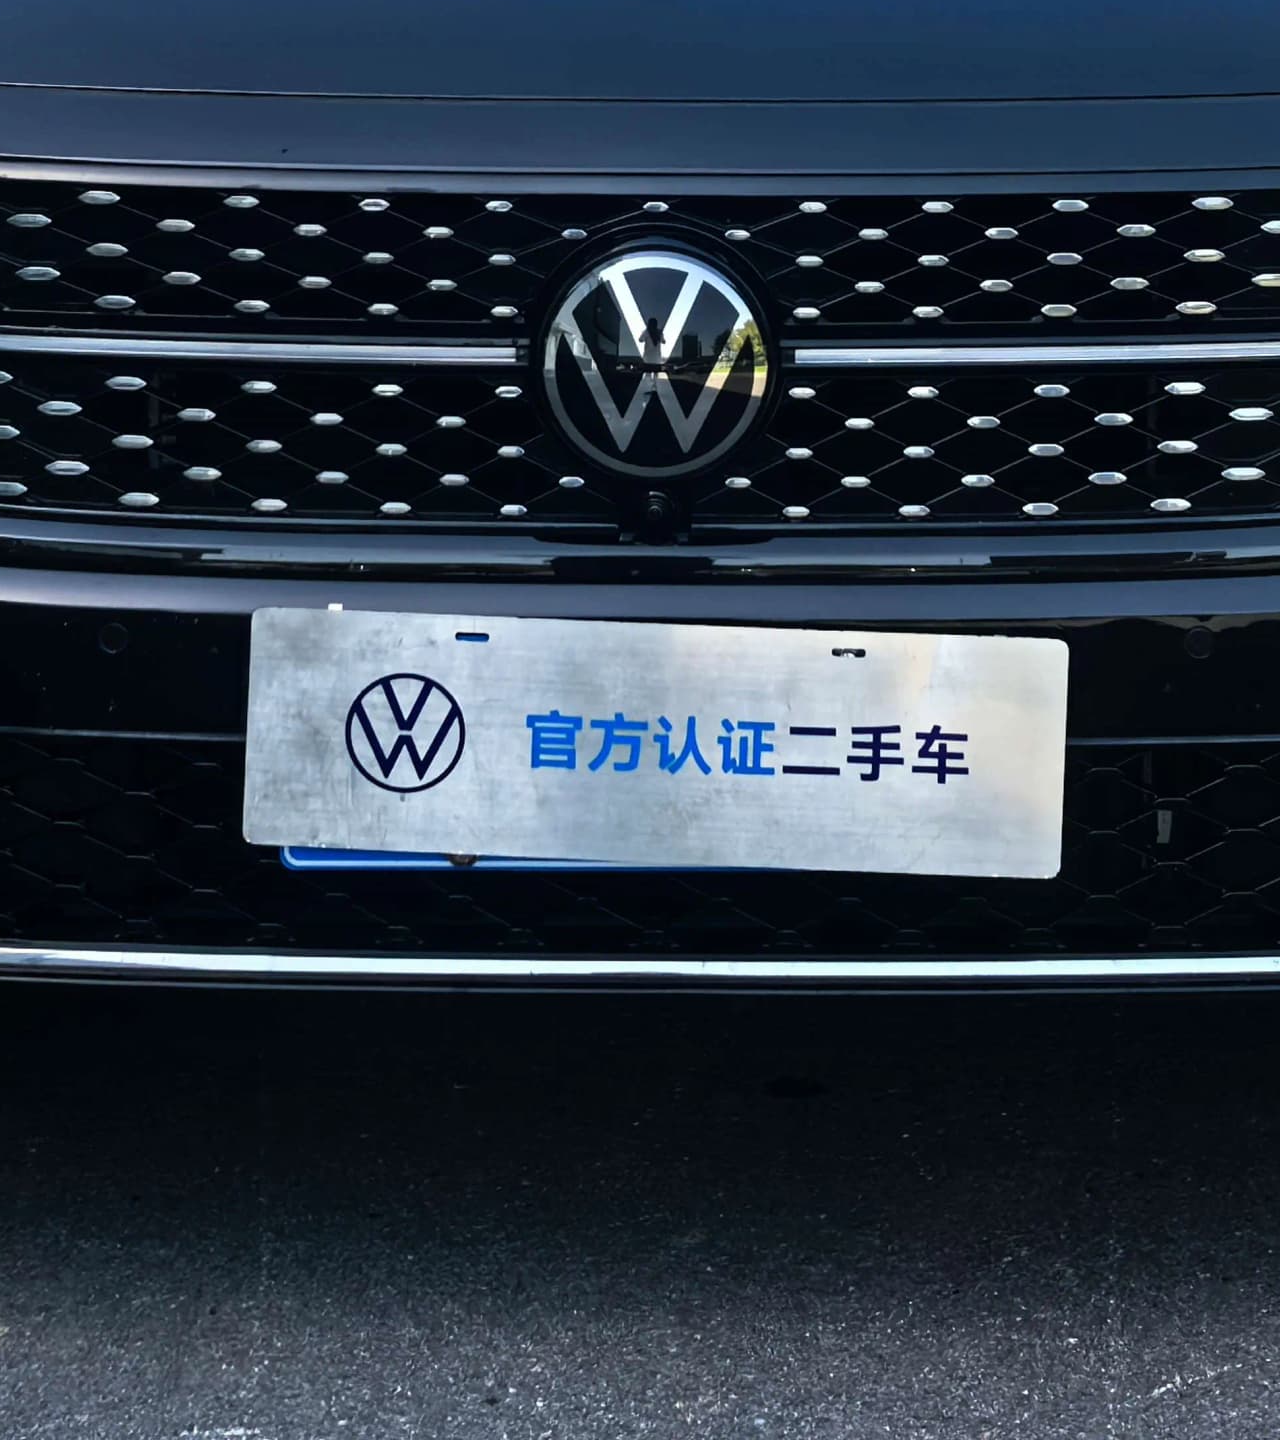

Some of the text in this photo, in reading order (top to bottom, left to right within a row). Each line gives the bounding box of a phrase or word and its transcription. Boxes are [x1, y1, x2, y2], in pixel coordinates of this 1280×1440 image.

[544, 251, 768, 477] VW
[345, 673, 466, 793] VW
[525, 709, 970, 785] 官方认证二手车
